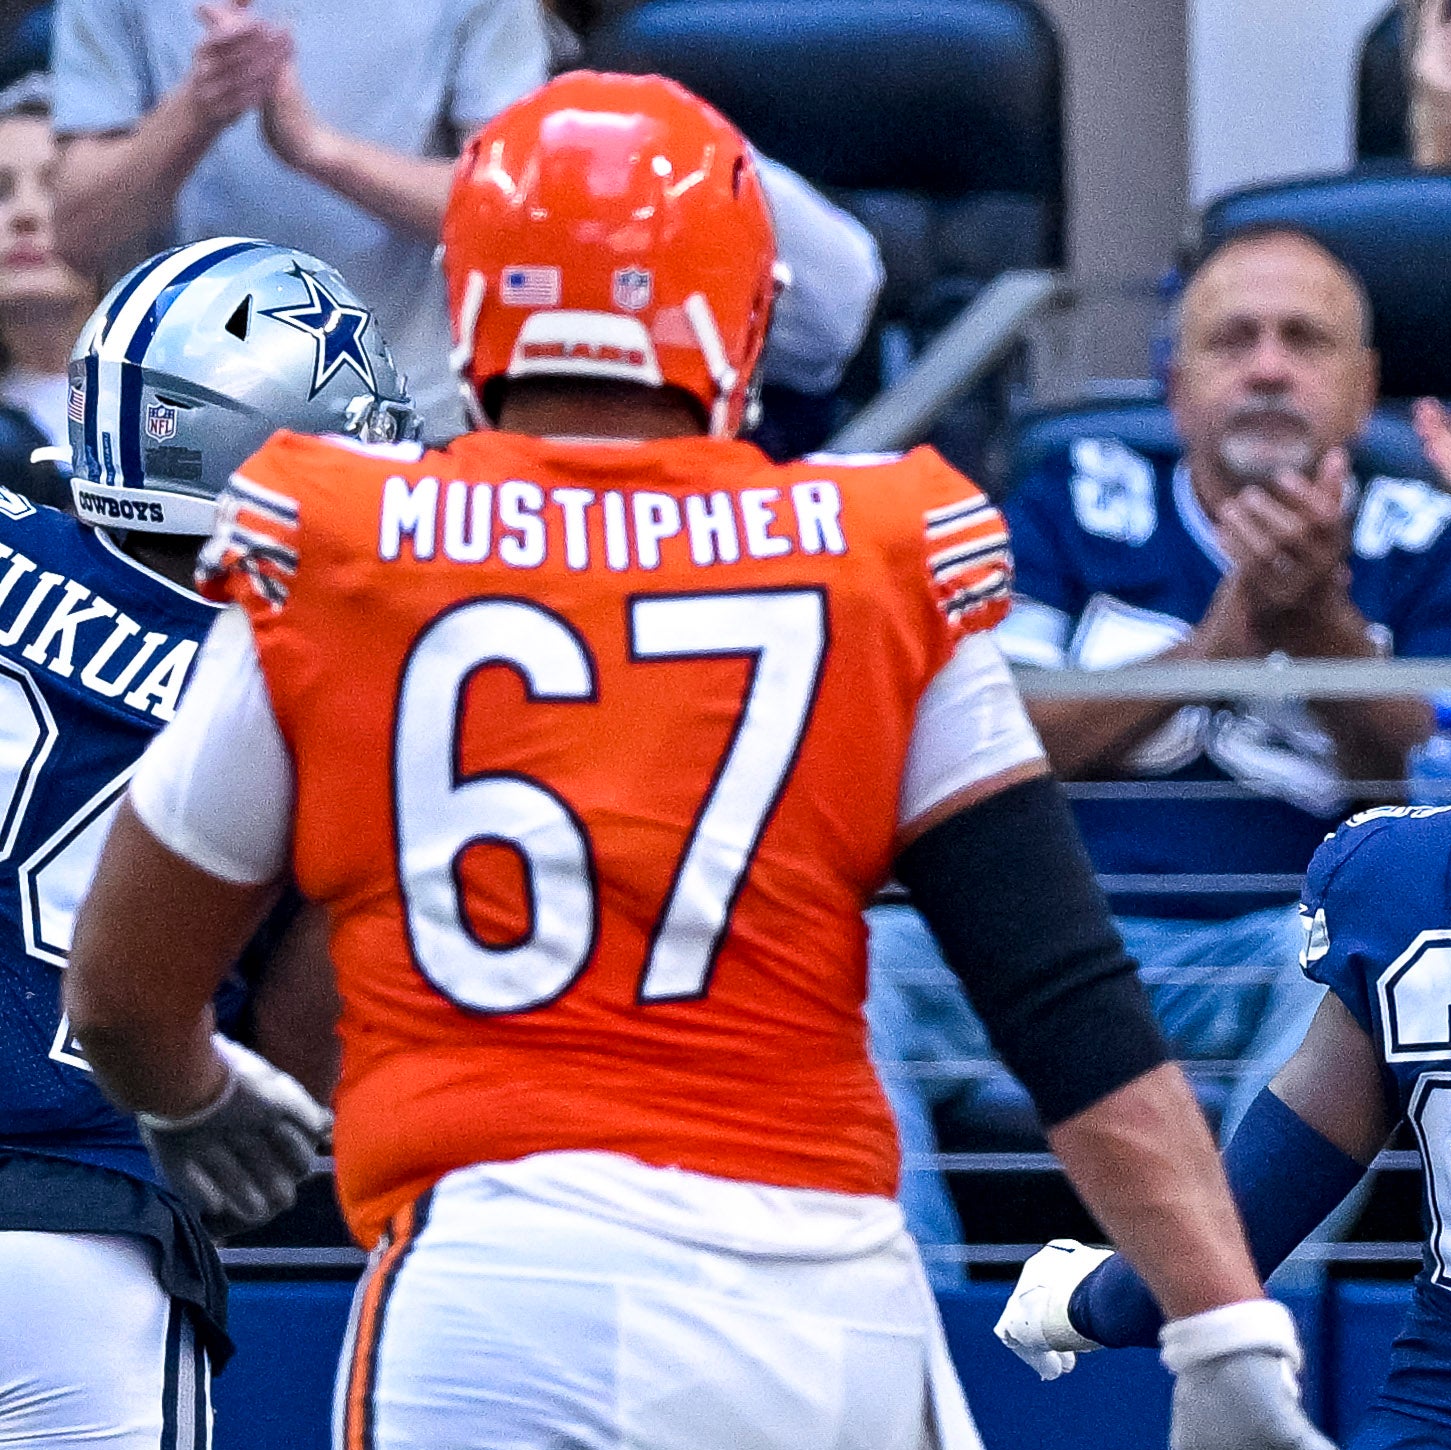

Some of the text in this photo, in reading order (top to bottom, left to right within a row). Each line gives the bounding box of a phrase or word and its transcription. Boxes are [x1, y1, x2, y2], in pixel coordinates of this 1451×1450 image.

[78, 491, 163, 522] COWBOYS
[378, 475, 848, 572] MUSTIPHER
[390, 583, 831, 1015] 67
